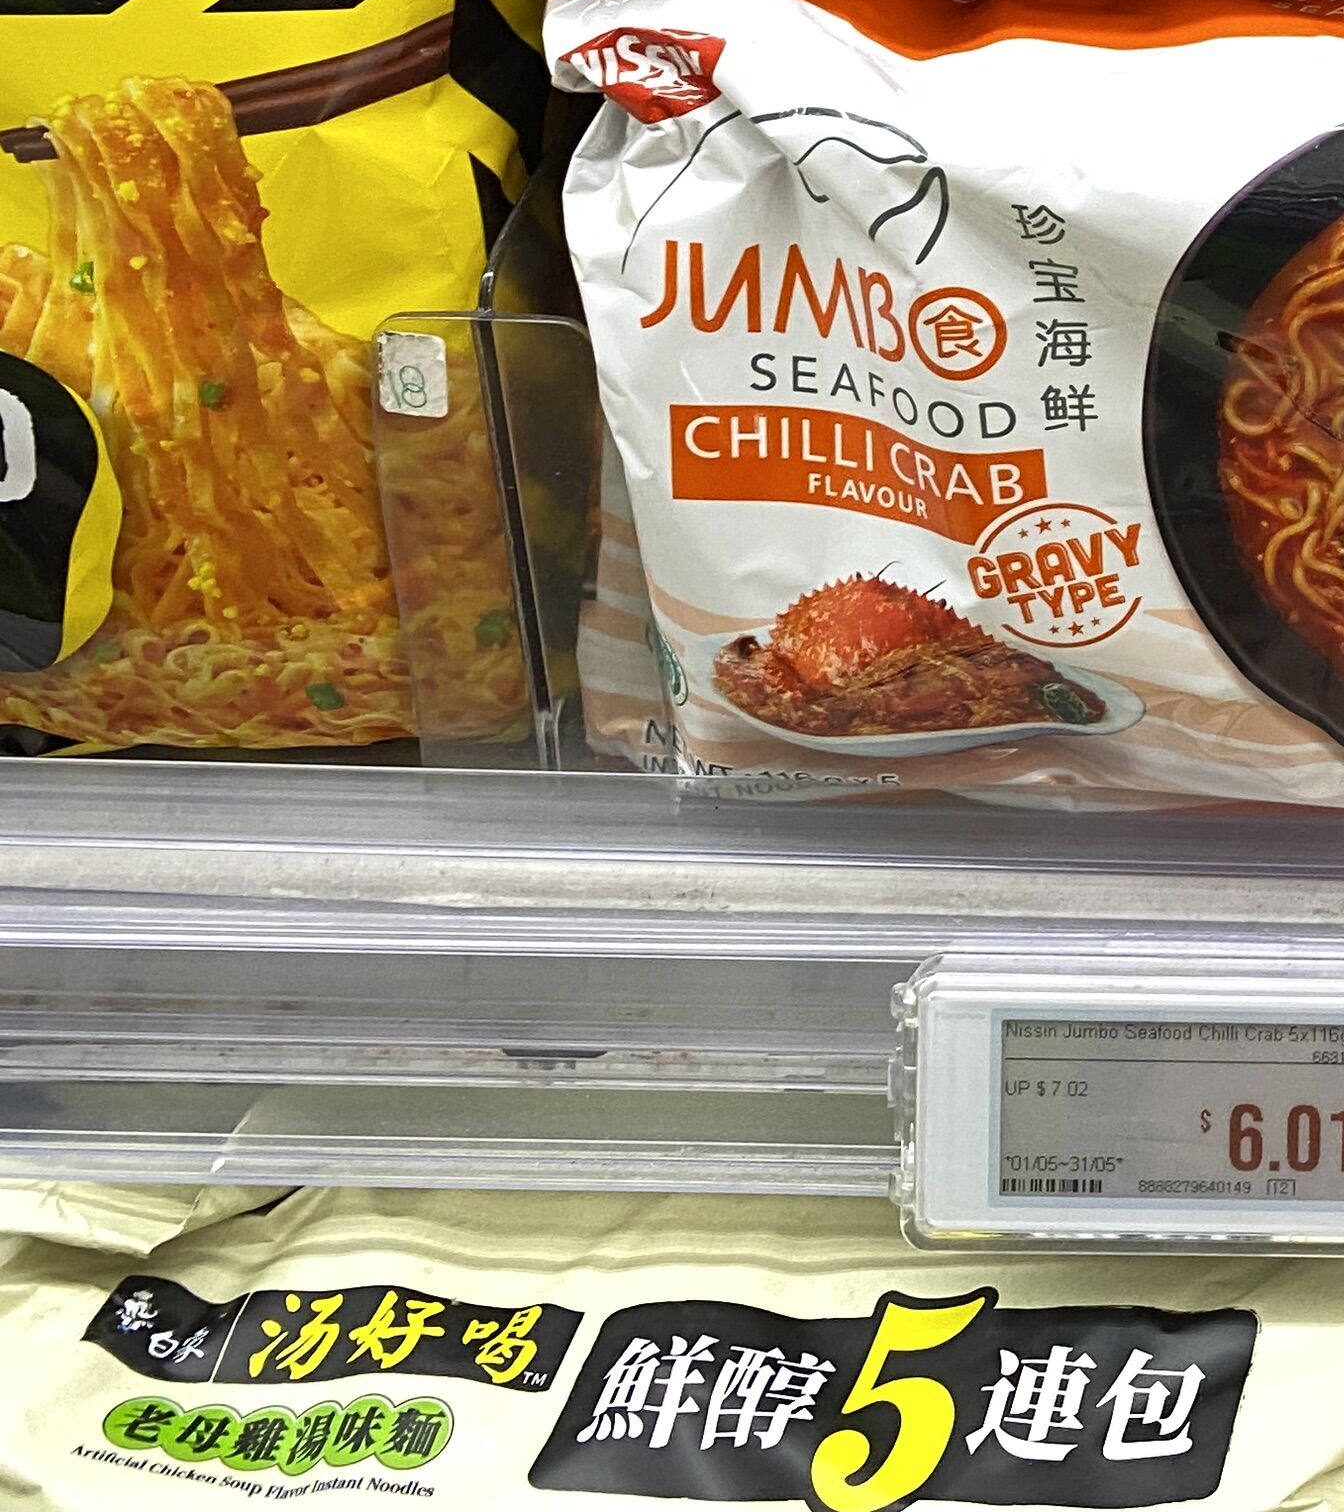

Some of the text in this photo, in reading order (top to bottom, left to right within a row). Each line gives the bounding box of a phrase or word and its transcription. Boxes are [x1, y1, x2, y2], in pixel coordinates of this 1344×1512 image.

[1011, 203, 1099, 434] 珍宝海鲜
[749, 352, 1017, 440] SEAFOOD
[684, 415, 1024, 506] CHILLI CRAB
[807, 473, 928, 519] FLAVOUR
[967, 523, 1141, 601] GRAVY
[1008, 573, 1126, 626] TYPE
[1005, 1023, 1058, 1038] Nissin
[1063, 1024, 1119, 1039] Jumbo
[1124, 1024, 1192, 1040] Seafood
[1198, 1025, 1239, 1042] Chilli
[1244, 1026, 1283, 1043] Crab
[1004, 1080, 1030, 1097] UP
[248, 1290, 544, 1384] 汤好喝
[522, 1372, 547, 1386] TM
[70, 1443, 436, 1500] Artificial Chicken Soup Flavor Instant Noodles
